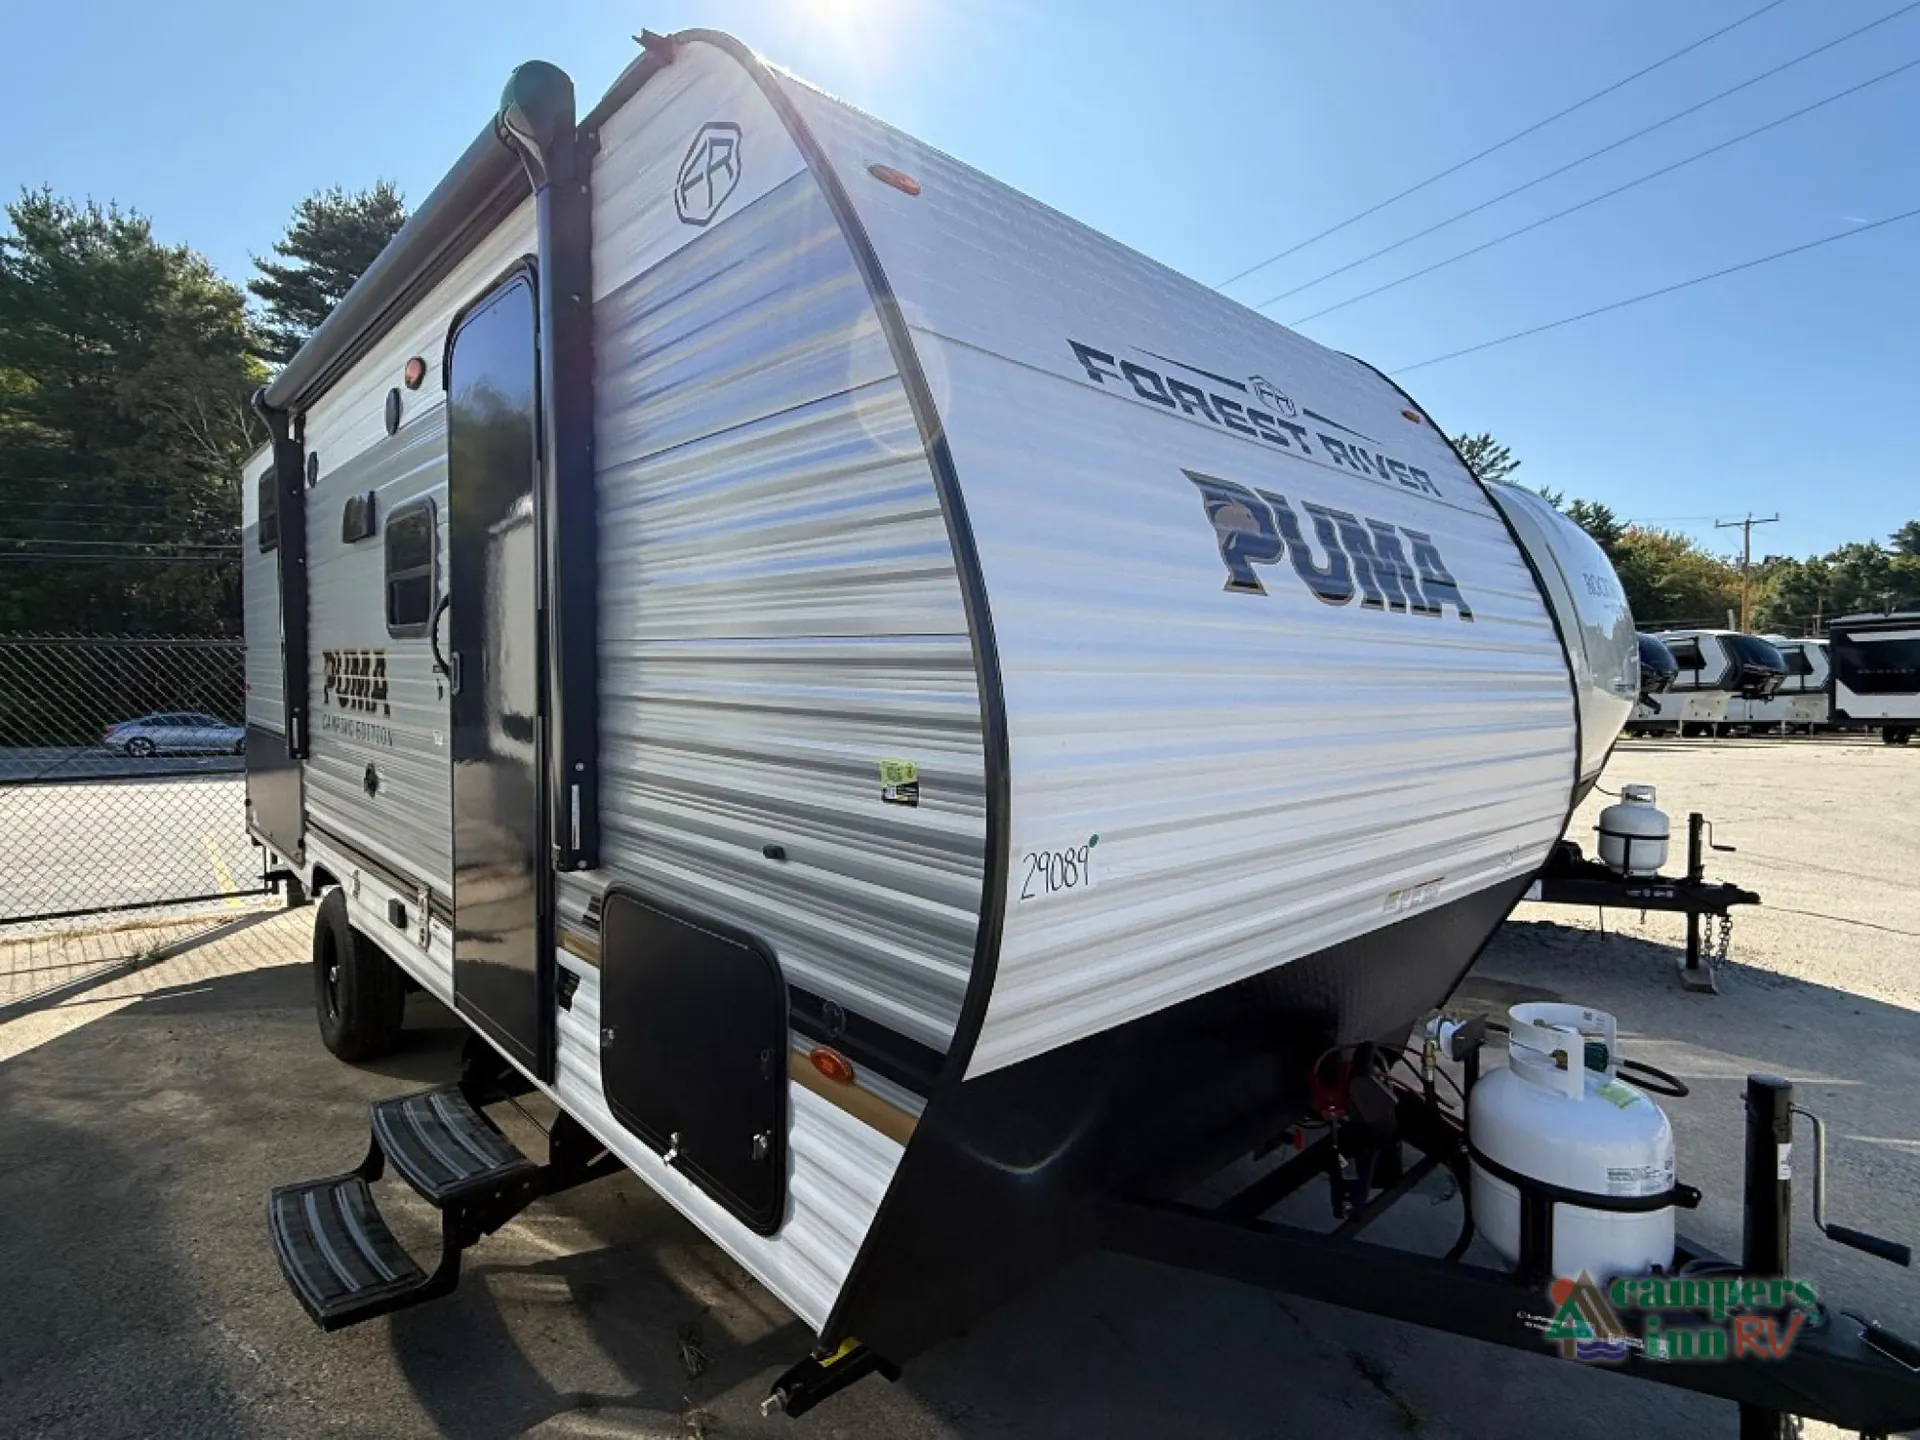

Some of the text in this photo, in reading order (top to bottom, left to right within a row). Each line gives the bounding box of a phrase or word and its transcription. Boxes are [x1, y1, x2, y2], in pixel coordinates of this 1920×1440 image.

[1066, 338, 1442, 497] FOREST RIVER
[1180, 468, 1474, 622] PUMA
[322, 648, 391, 719] PUMA
[355, 720, 393, 747] EDITION
[1020, 845, 1089, 901] 29089
